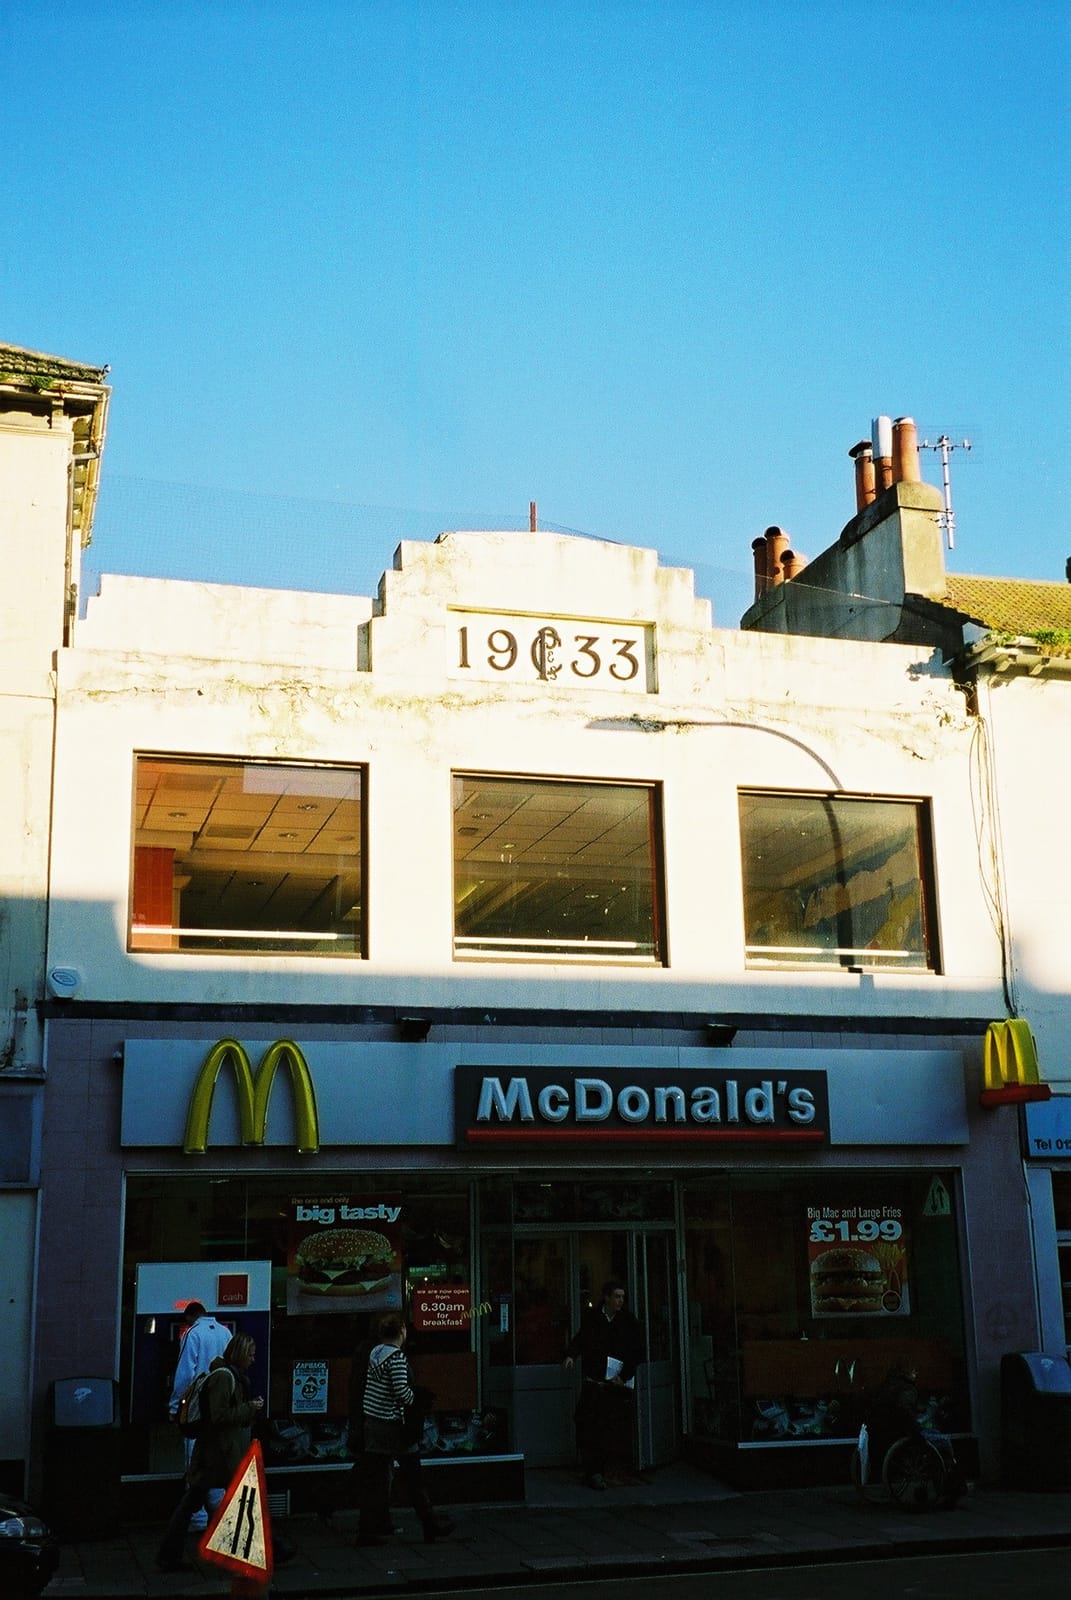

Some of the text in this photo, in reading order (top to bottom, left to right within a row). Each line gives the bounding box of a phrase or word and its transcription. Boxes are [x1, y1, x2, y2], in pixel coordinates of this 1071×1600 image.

[476, 1076, 817, 1123] McDonald's
[1034, 1138, 1051, 1150] Tel
[296, 1203, 402, 1225] big tasty
[807, 1206, 902, 1220] Big Mac and Large Fries
[809, 1219, 903, 1242] £1.99
[222, 1293, 244, 1302] cash
[420, 1302, 465, 1312] 6.30am
